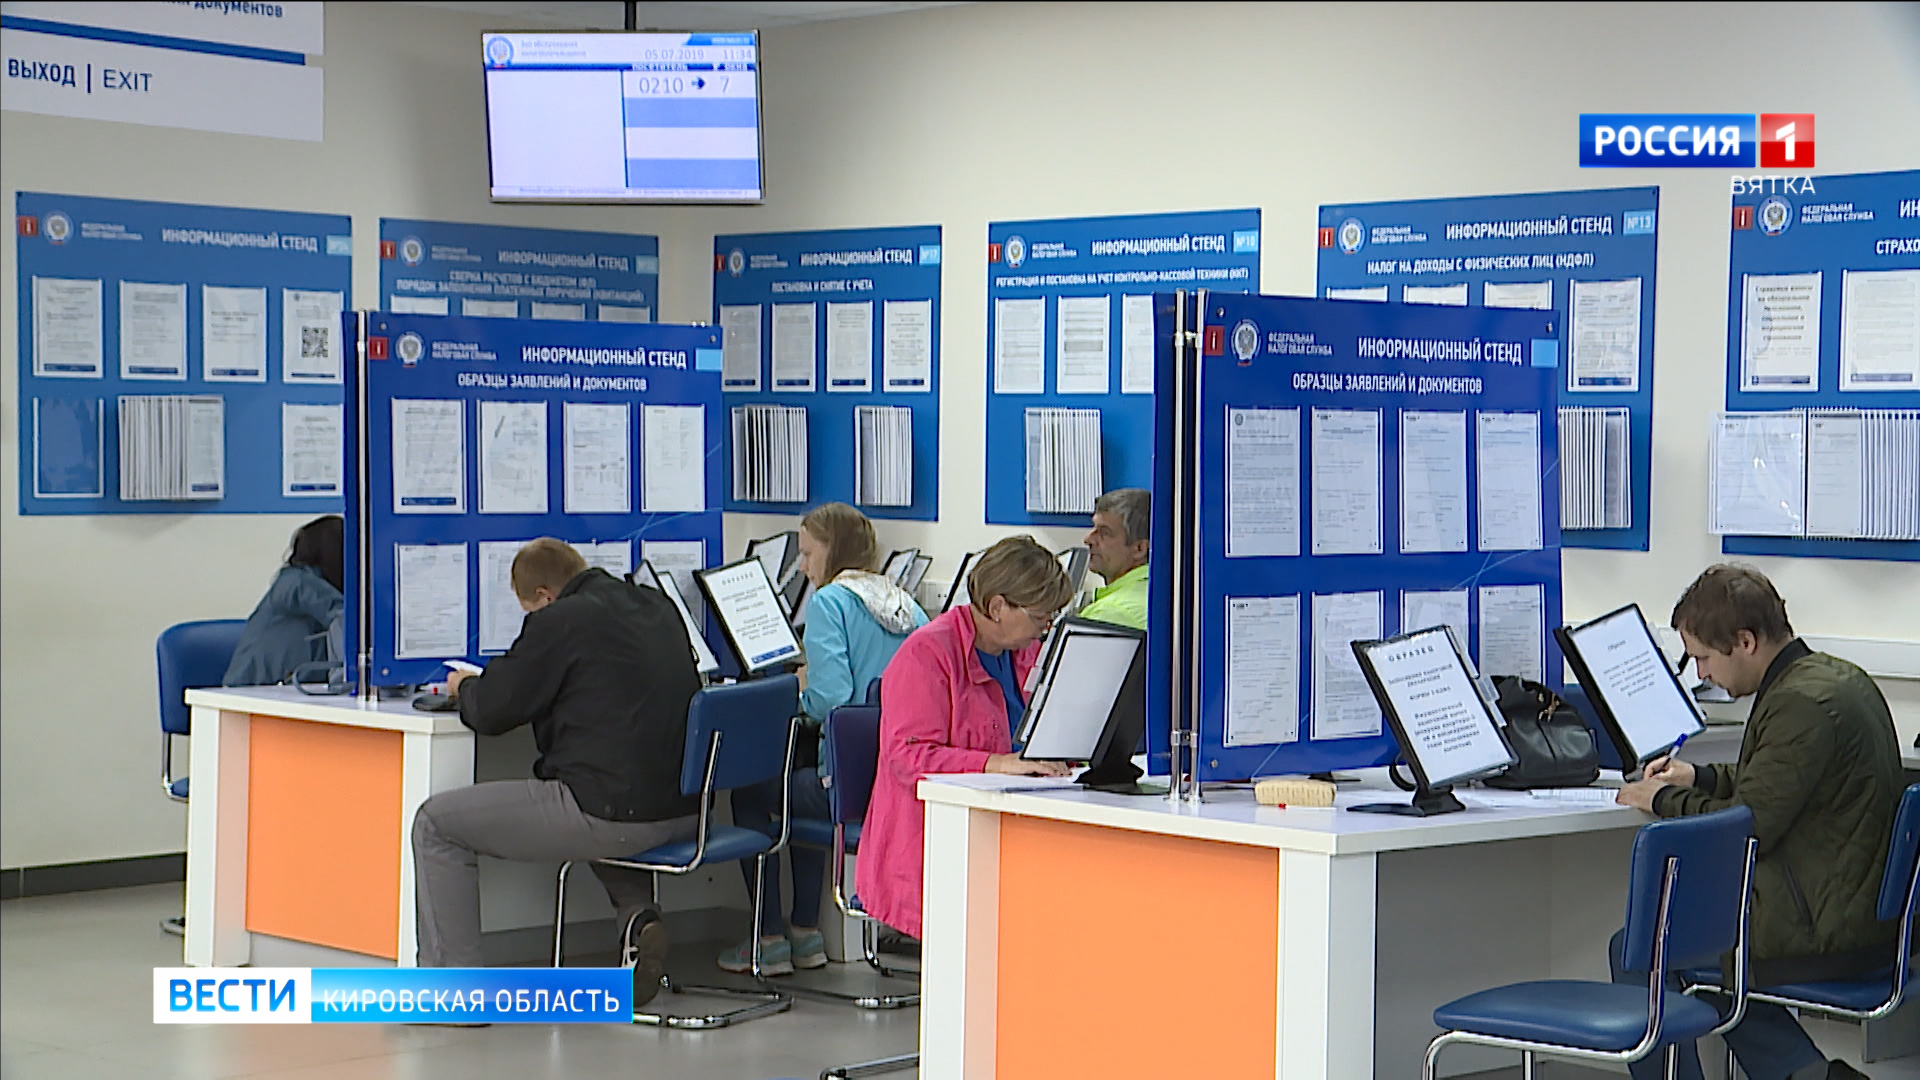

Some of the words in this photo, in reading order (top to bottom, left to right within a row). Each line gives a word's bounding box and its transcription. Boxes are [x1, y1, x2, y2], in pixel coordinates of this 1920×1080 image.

[645, 49, 704, 60] 05.07.2019
[723, 49, 752, 60] 11:34
[8, 58, 76, 87] ВЫХОД
[103, 69, 152, 92] EXIT
[639, 77, 683, 94] 0210
[721, 76, 730, 94] 7
[1446, 215, 1568, 241] ИНФОРМАЦИОННЫЙ
[1570, 216, 1613, 235] СТЕНД
[162, 228, 280, 249] ИНФОРМАЦИОННЫЙ
[281, 235, 319, 253] СТЕНД
[1091, 234, 1190, 255] ИНФОРМАЦИОННЫЙ
[1192, 235, 1225, 253] СТЕНД
[498, 250, 597, 268] ИНФОРМАЦИОННЫЙ
[598, 255, 629, 272] СТЕНД
[800, 247, 883, 267] ИНФОРМАЦИОННЫЙ
[884, 248, 913, 265] СТЕНД
[1367, 259, 1397, 274] НАЛОГ
[1398, 260, 1412, 273] НА
[1413, 257, 1454, 274] ДОХОДЫ
[1456, 258, 1462, 271] С
[1464, 255, 1529, 271] ФИЗИЧЕСКИХ
[1532, 254, 1554, 270] ЛИЦ
[1556, 252, 1596, 268] (НДФЛ)
[522, 345, 646, 368] ИНФОРМАЦИОННЫЙ
[648, 350, 687, 370] СТЕНД
[1358, 337, 1481, 363] ИНФОРМАЦИОННЫЙ
[1484, 342, 1522, 366] СТЕНД
[457, 373, 508, 389] ОБРАЗЦЫ
[509, 372, 571, 390] ЗАЯВЛЕНИЙ
[573, 376, 581, 389] И
[582, 376, 647, 392] ДОКУМЕНТОВ
[1293, 373, 1343, 392] ОБРАЗЦЫ
[1345, 372, 1406, 393] ЗАЯВЛЕНИЙ
[1408, 376, 1417, 392] И
[1418, 377, 1483, 395] ДОКУМЕНТОВ
